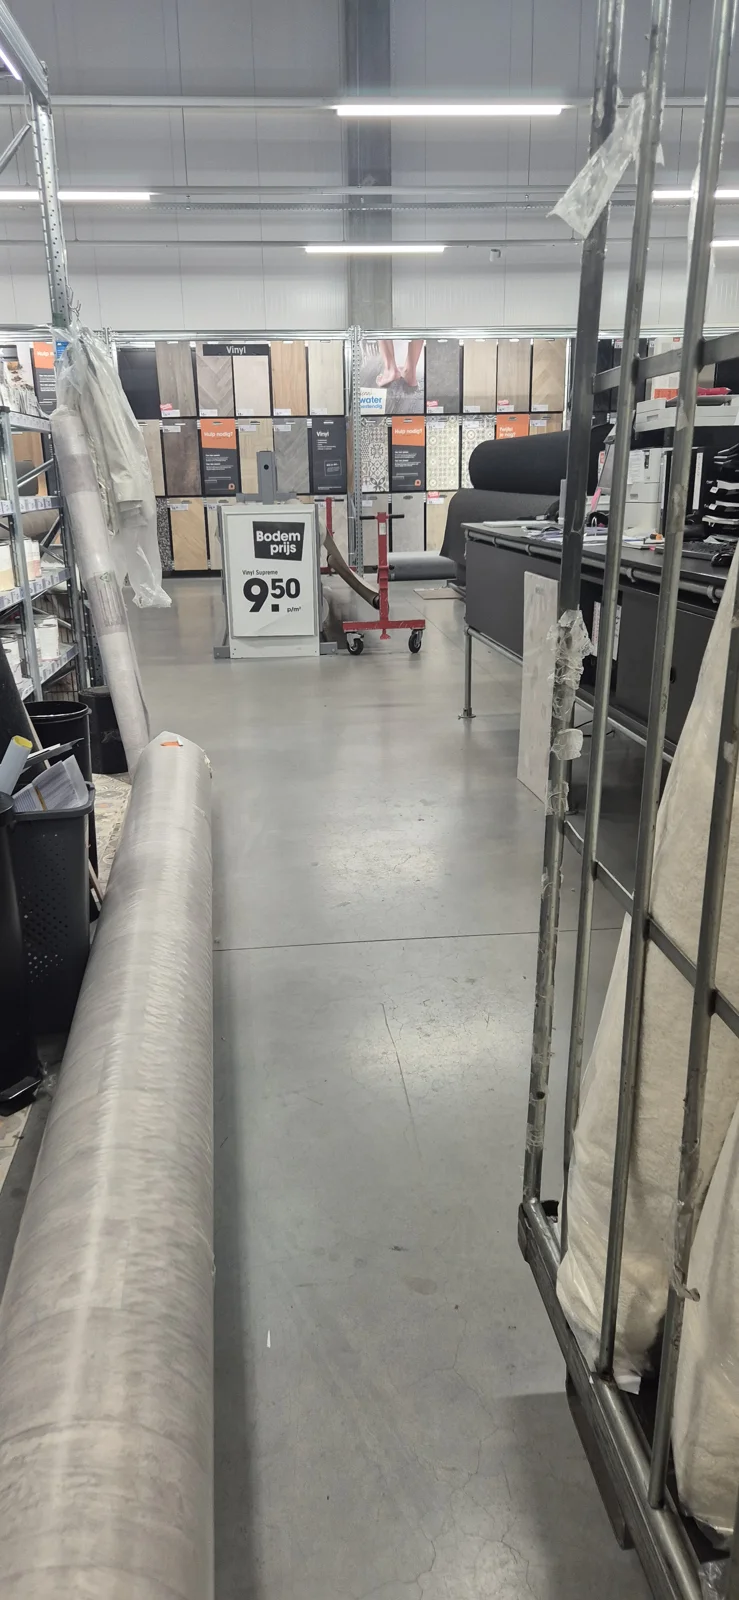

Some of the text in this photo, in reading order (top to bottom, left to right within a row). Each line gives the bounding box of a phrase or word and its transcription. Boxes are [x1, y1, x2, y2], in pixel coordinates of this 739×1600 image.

[226, 346, 246, 355] Vinyl
[256, 530, 301, 542] Bodem
[270, 542, 297, 555] prijs
